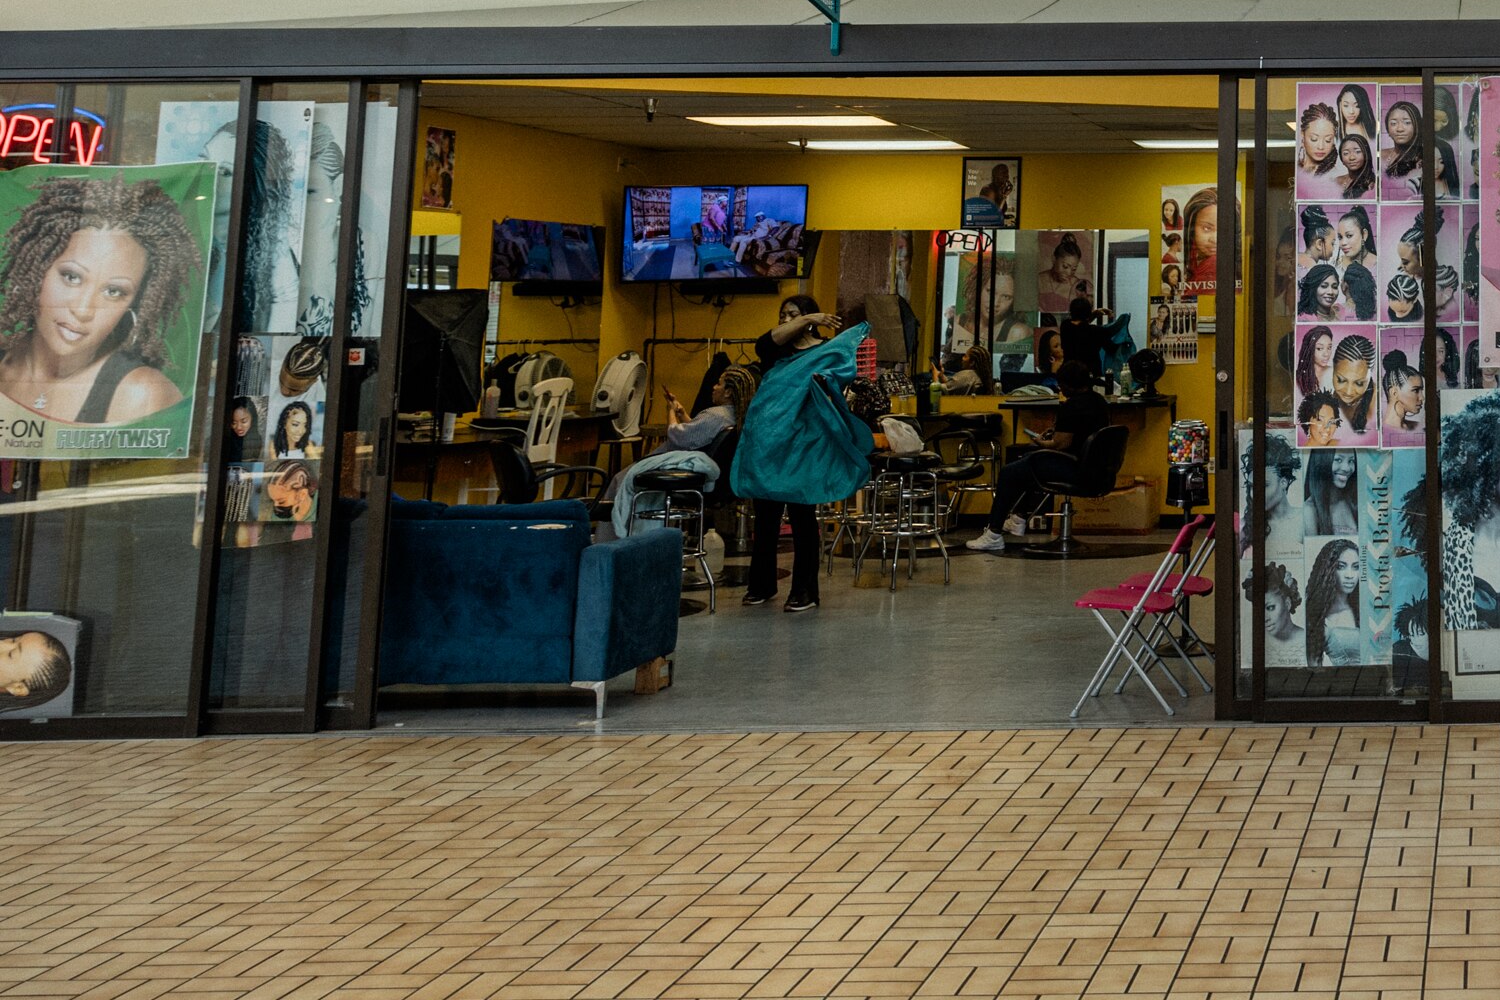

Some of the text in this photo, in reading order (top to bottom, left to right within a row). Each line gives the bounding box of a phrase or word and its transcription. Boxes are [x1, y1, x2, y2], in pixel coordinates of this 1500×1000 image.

[937, 230, 988, 252] OPEN
[1178, 280, 1243, 290] INVISE
[4, 438, 43, 448] Natural
[56, 428, 170, 449] FLUFFY TWIST
[1372, 475, 1390, 610] Prota Braids
